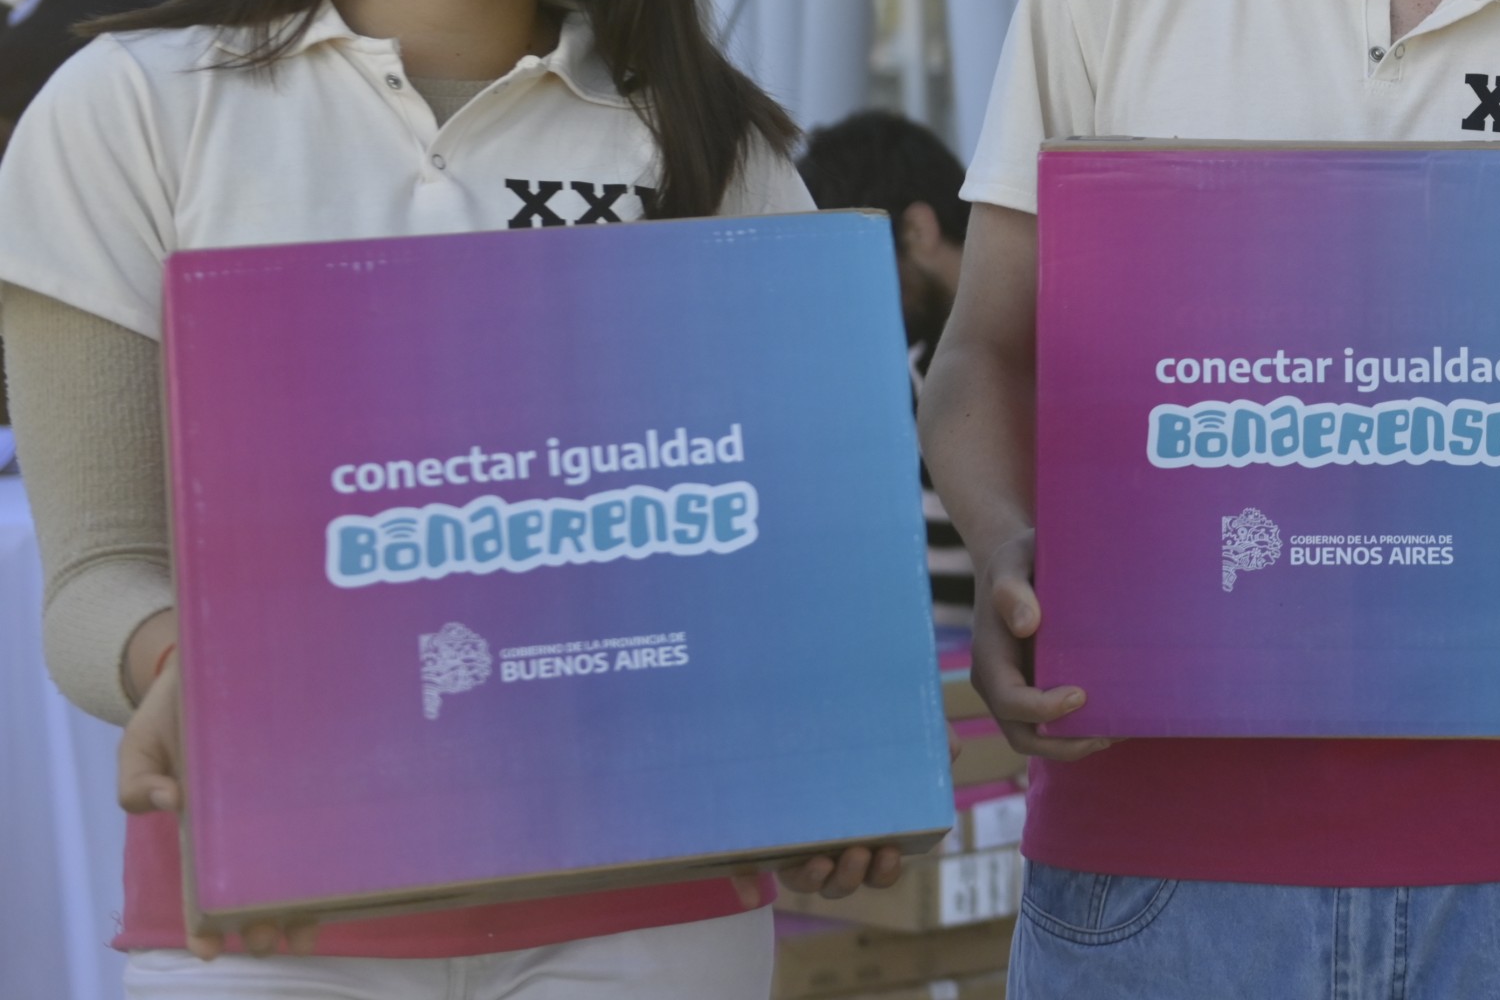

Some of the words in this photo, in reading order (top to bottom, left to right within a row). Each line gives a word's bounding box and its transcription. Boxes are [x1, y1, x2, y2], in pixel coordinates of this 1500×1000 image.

[1155, 349, 1333, 384] conectar
[331, 446, 536, 493] conectar
[546, 423, 744, 486] igualdad
[1290, 535, 1345, 545] GOBIERNO
[1347, 535, 1362, 544] DE
[1363, 535, 1378, 545] LA
[1379, 535, 1436, 545] PROVINCIA
[1438, 535, 1453, 544] DE
[1290, 546, 1383, 566] BUENOS
[1388, 546, 1454, 566] AIRES
[501, 652, 609, 683] BUENOS
[614, 645, 690, 672] AIRES
